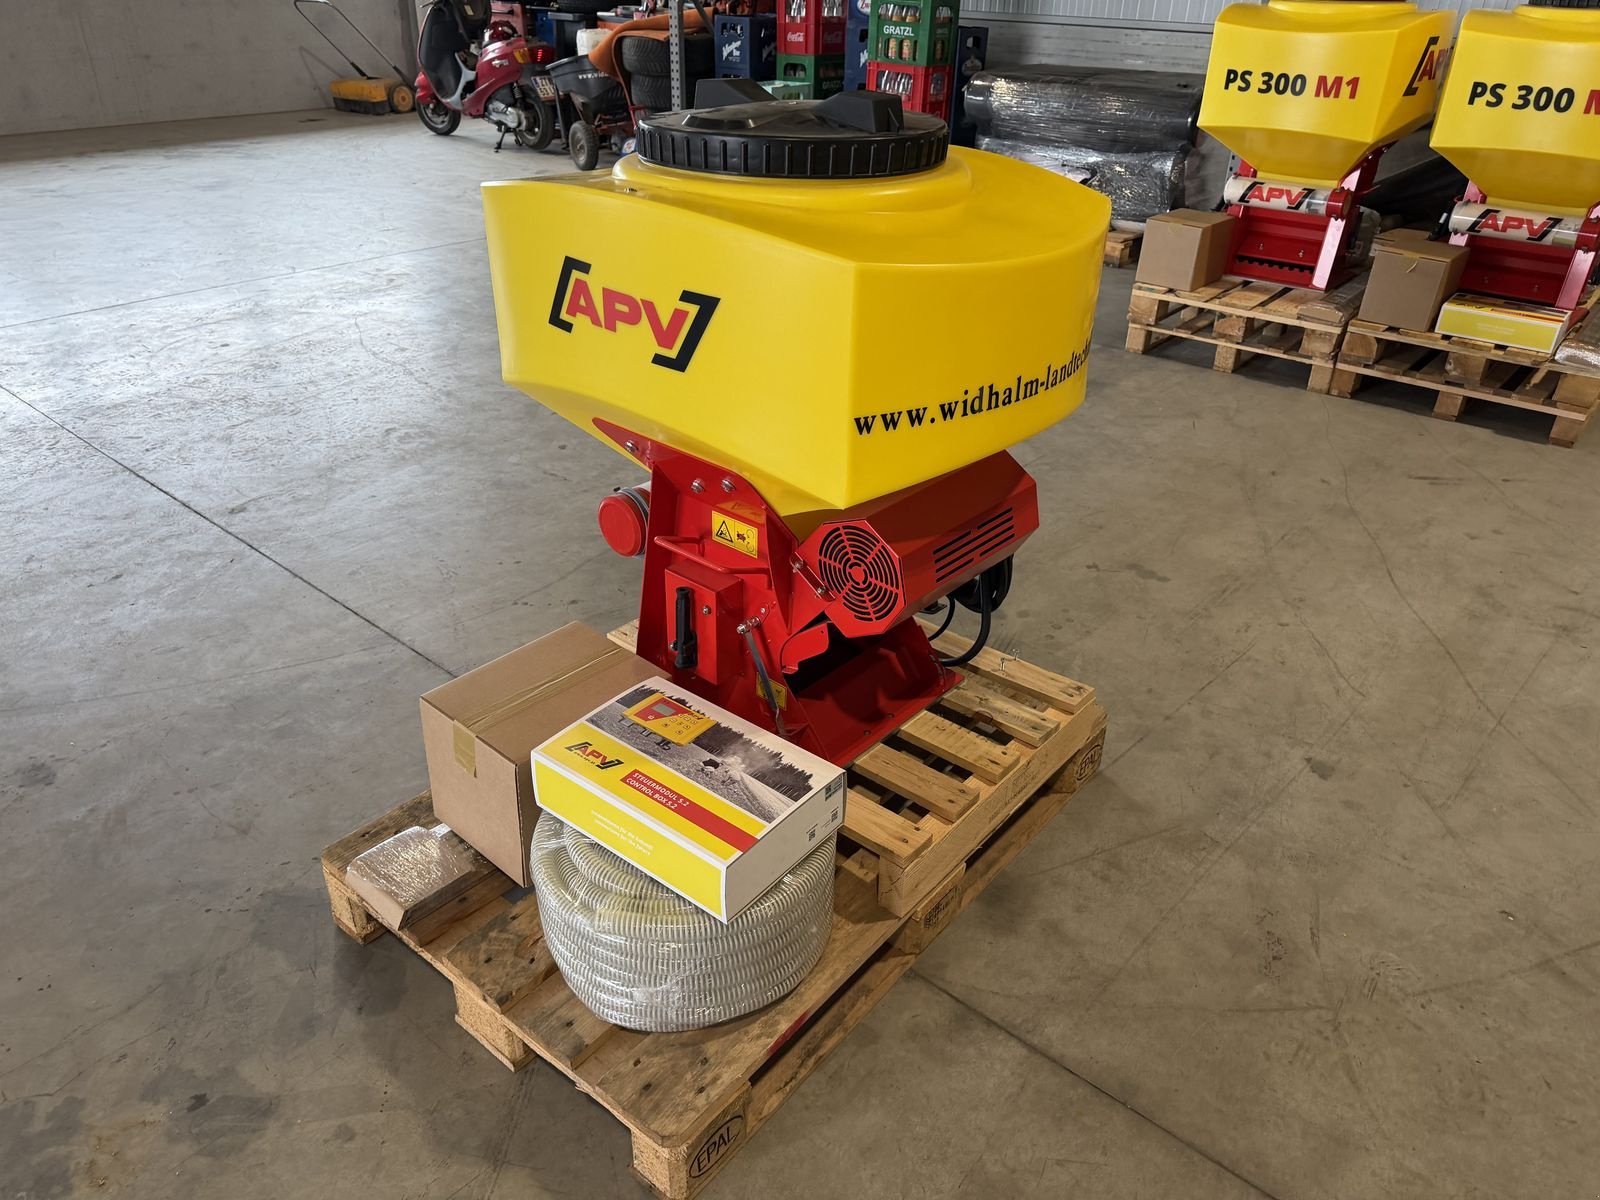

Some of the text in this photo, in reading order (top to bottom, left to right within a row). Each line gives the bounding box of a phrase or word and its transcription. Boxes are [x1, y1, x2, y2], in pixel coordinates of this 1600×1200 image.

[883, 25, 915, 36] GRATZL
[1224, 69, 1361, 100] PS 300 M1
[1467, 81, 1506, 107] PS
[1511, 84, 1575, 113] 300
[626, 777, 678, 810] CONTROL BOX 5.2
[632, 772, 690, 807] STEUERMODUL 5.2
[696, 1126, 736, 1173] EPAL
